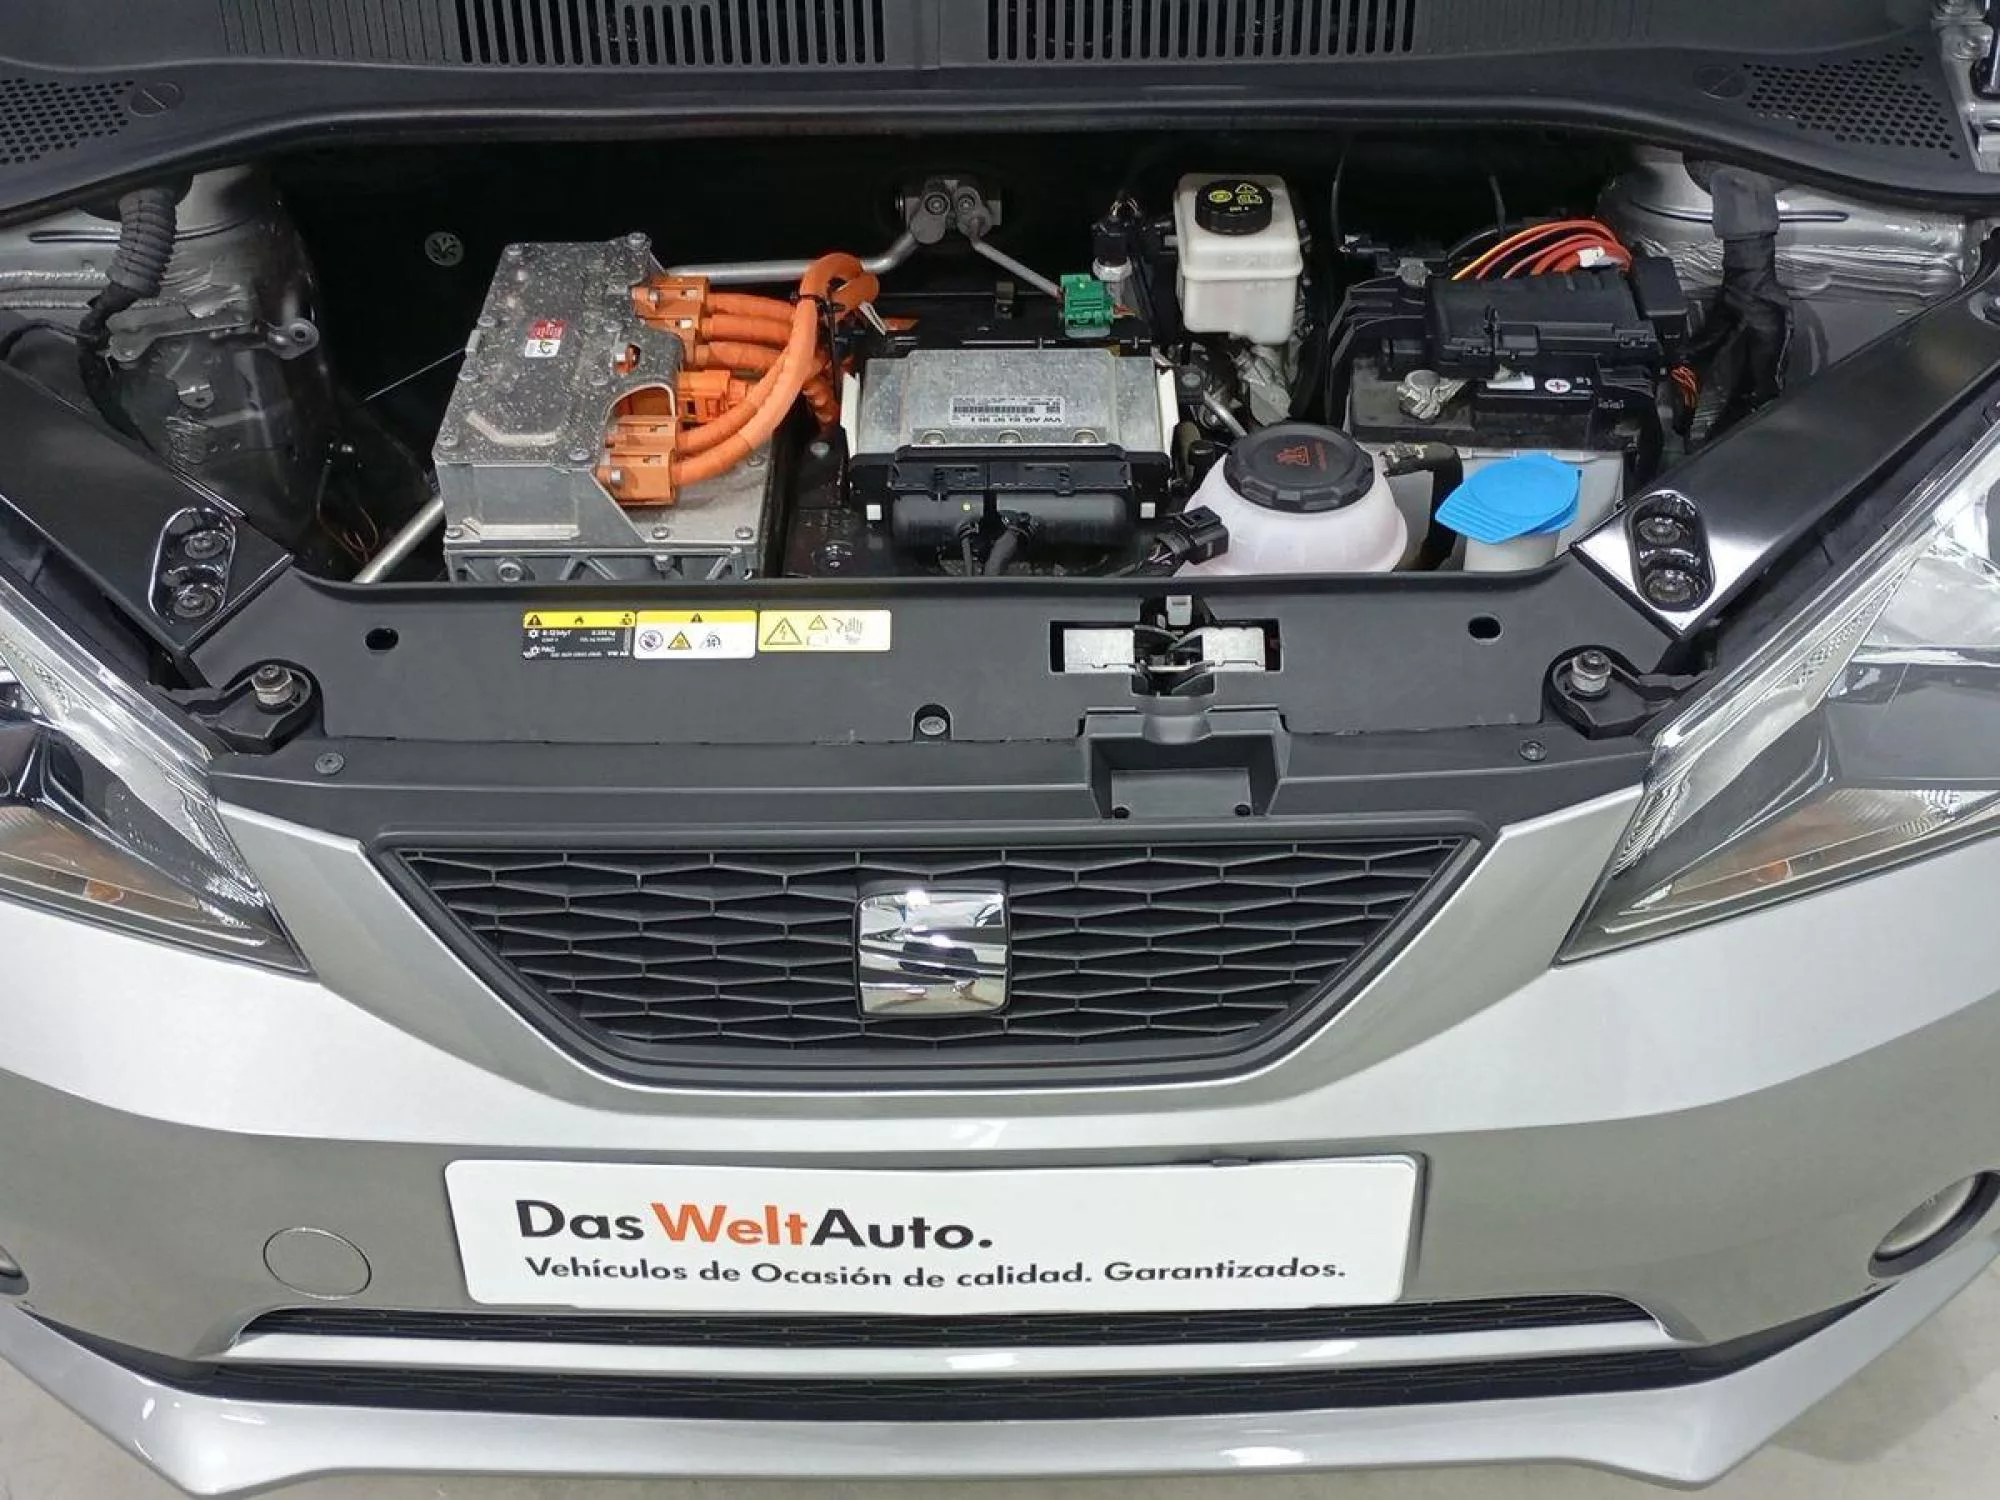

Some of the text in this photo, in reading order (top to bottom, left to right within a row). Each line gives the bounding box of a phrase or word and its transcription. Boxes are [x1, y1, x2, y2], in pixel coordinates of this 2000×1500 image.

[515, 1199, 645, 1241] Das
[524, 1256, 1347, 1288] Vehículos de Ocasión de calidad. Garantizados.
